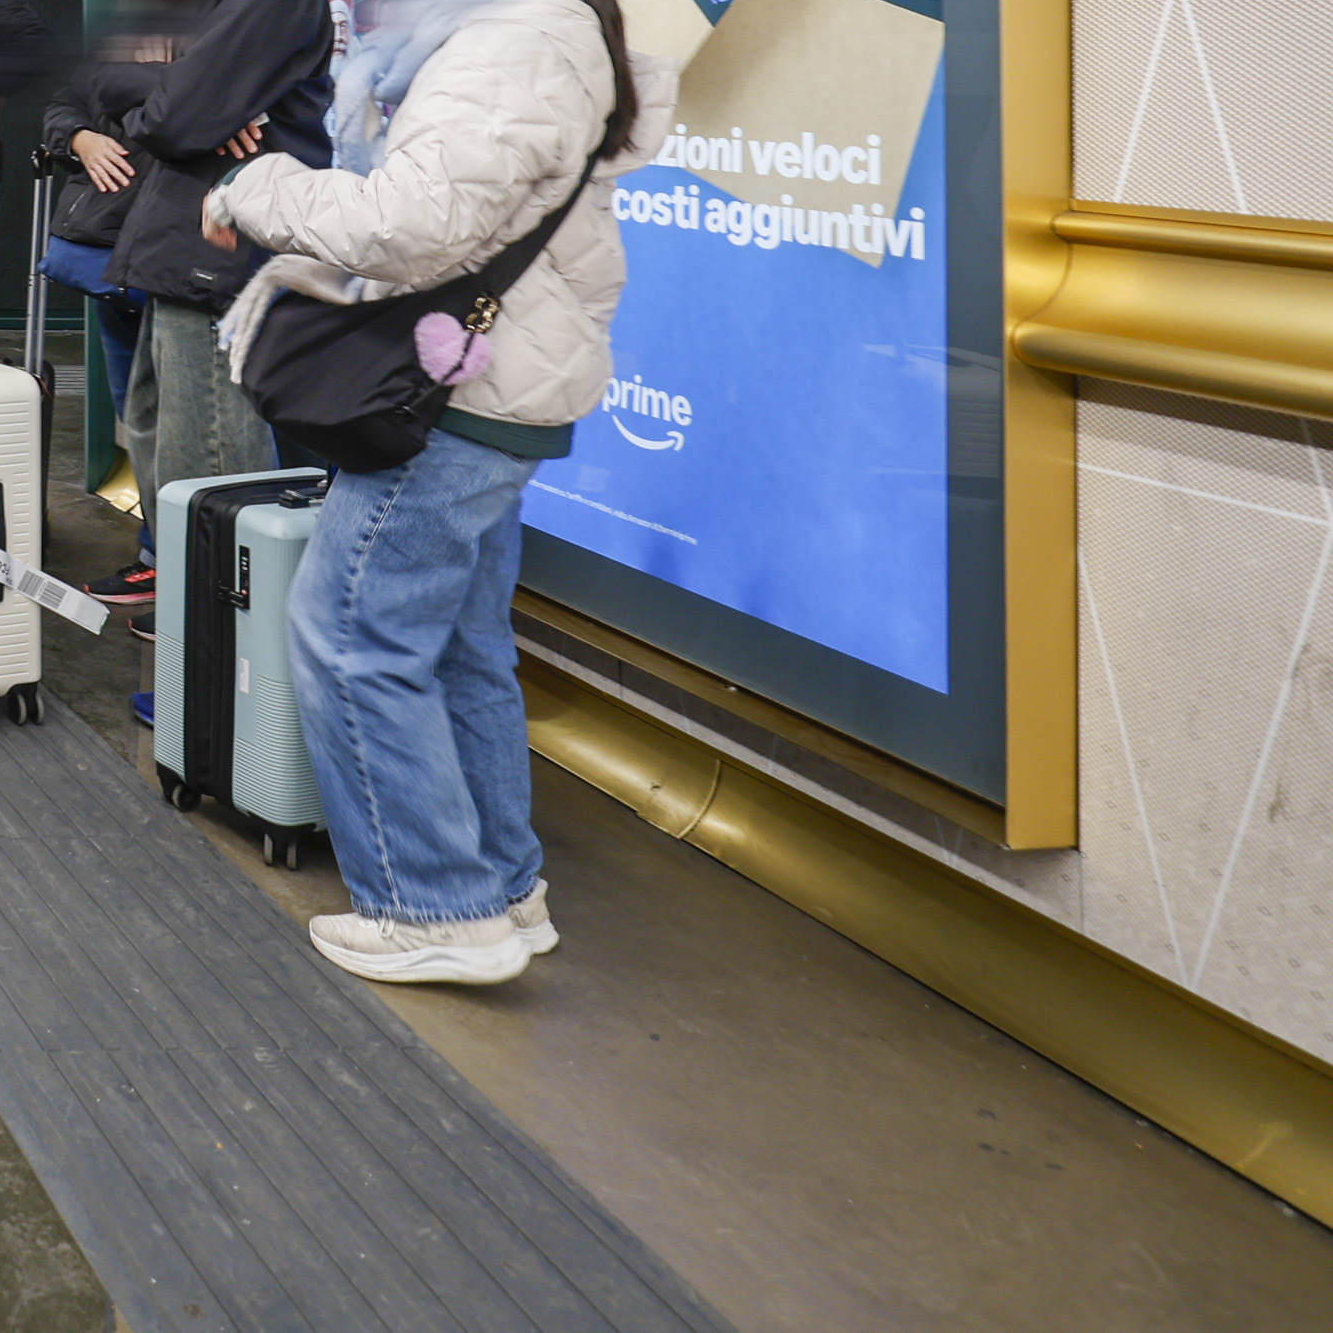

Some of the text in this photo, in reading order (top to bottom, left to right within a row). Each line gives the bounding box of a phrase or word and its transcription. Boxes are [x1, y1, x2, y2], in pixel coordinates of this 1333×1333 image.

[646, 123, 883, 186] zioni veloci
[611, 184, 926, 261] costi aggiuntivi
[602, 374, 693, 426] prime
